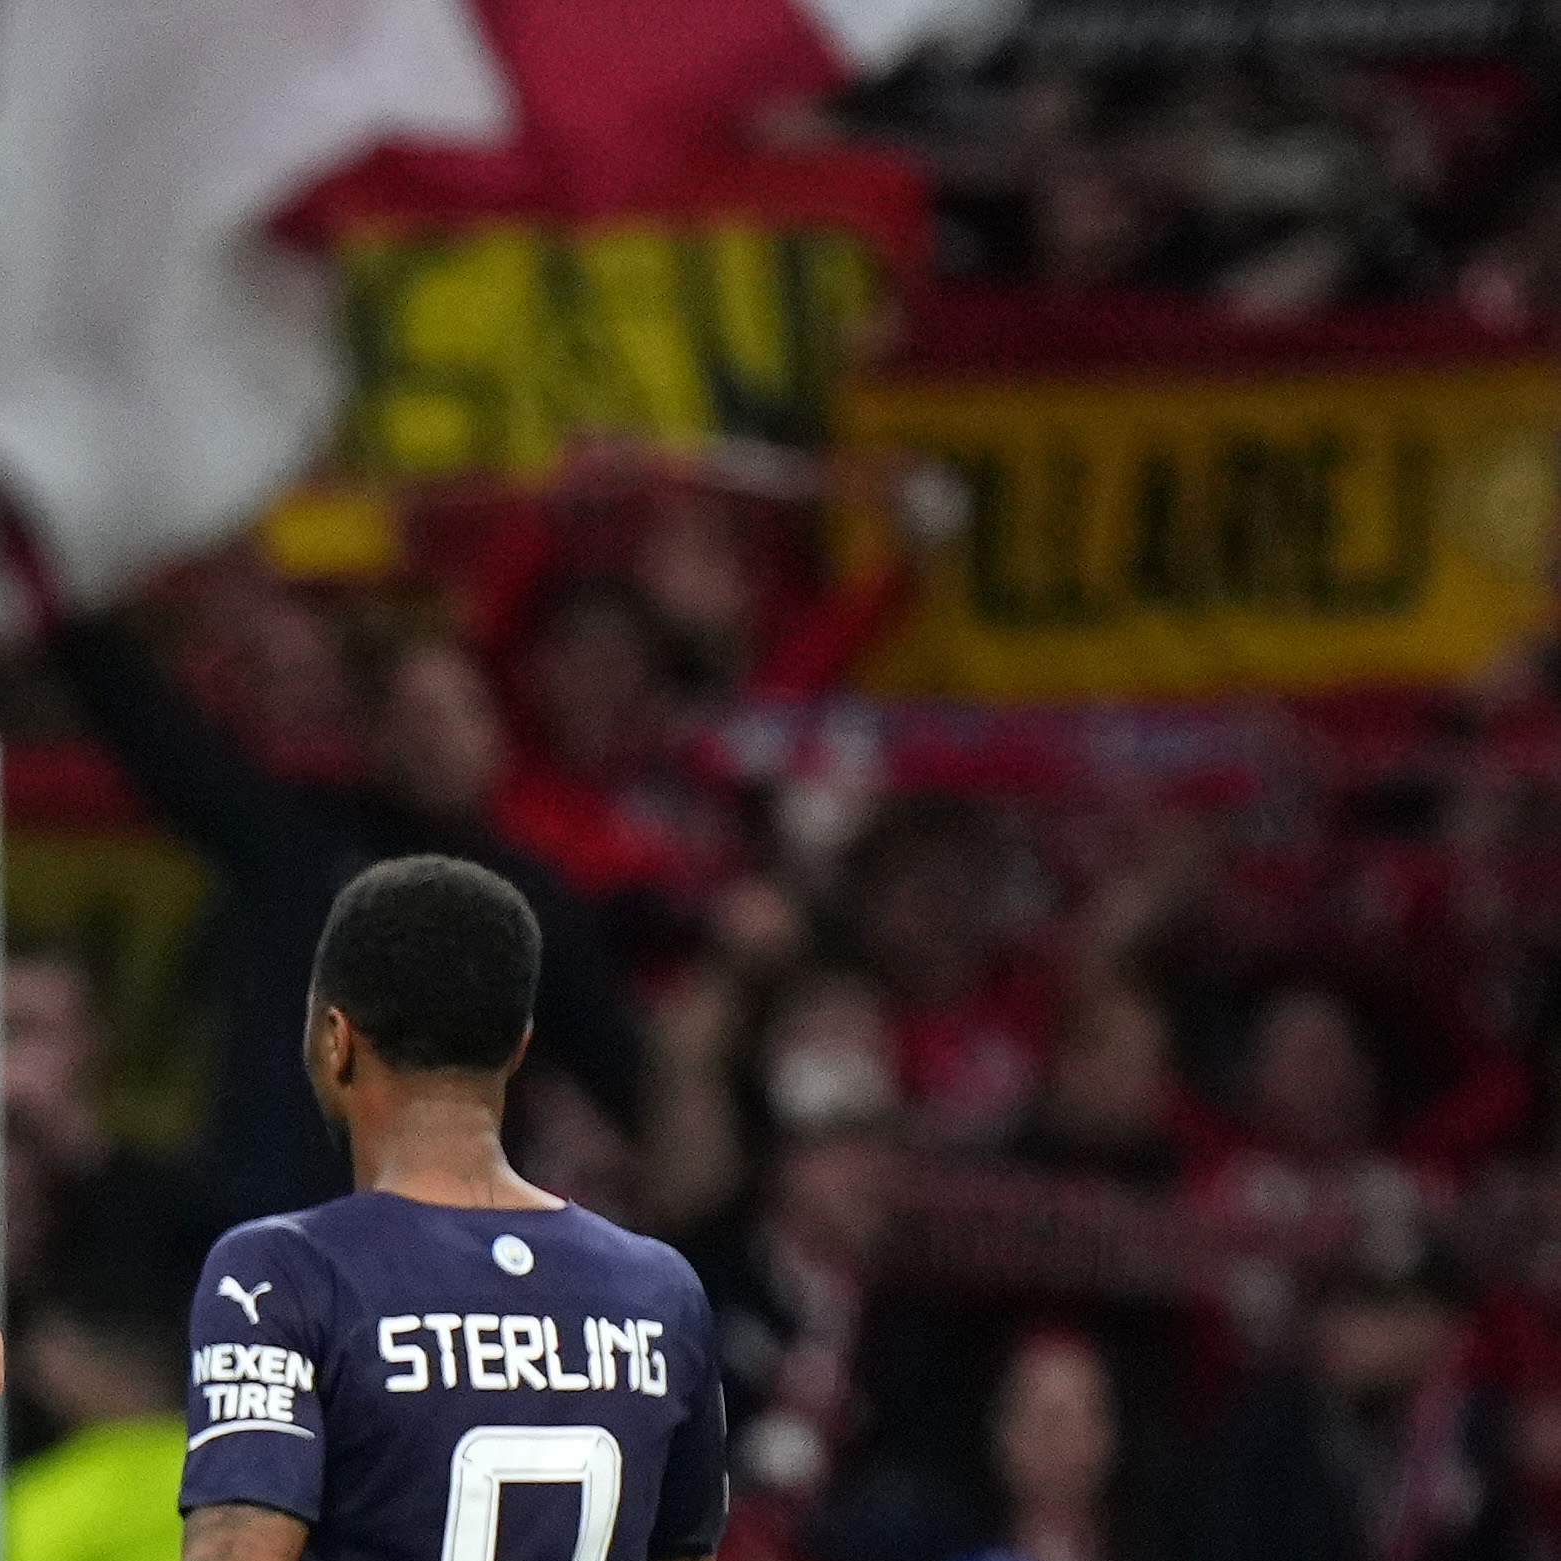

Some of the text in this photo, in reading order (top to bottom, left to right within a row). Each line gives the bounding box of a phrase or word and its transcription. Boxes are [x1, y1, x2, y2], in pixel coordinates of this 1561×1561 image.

[193, 1342, 316, 1393] NEXEN
[377, 1313, 669, 1398] STERLING
[203, 1382, 296, 1422] TIRE
